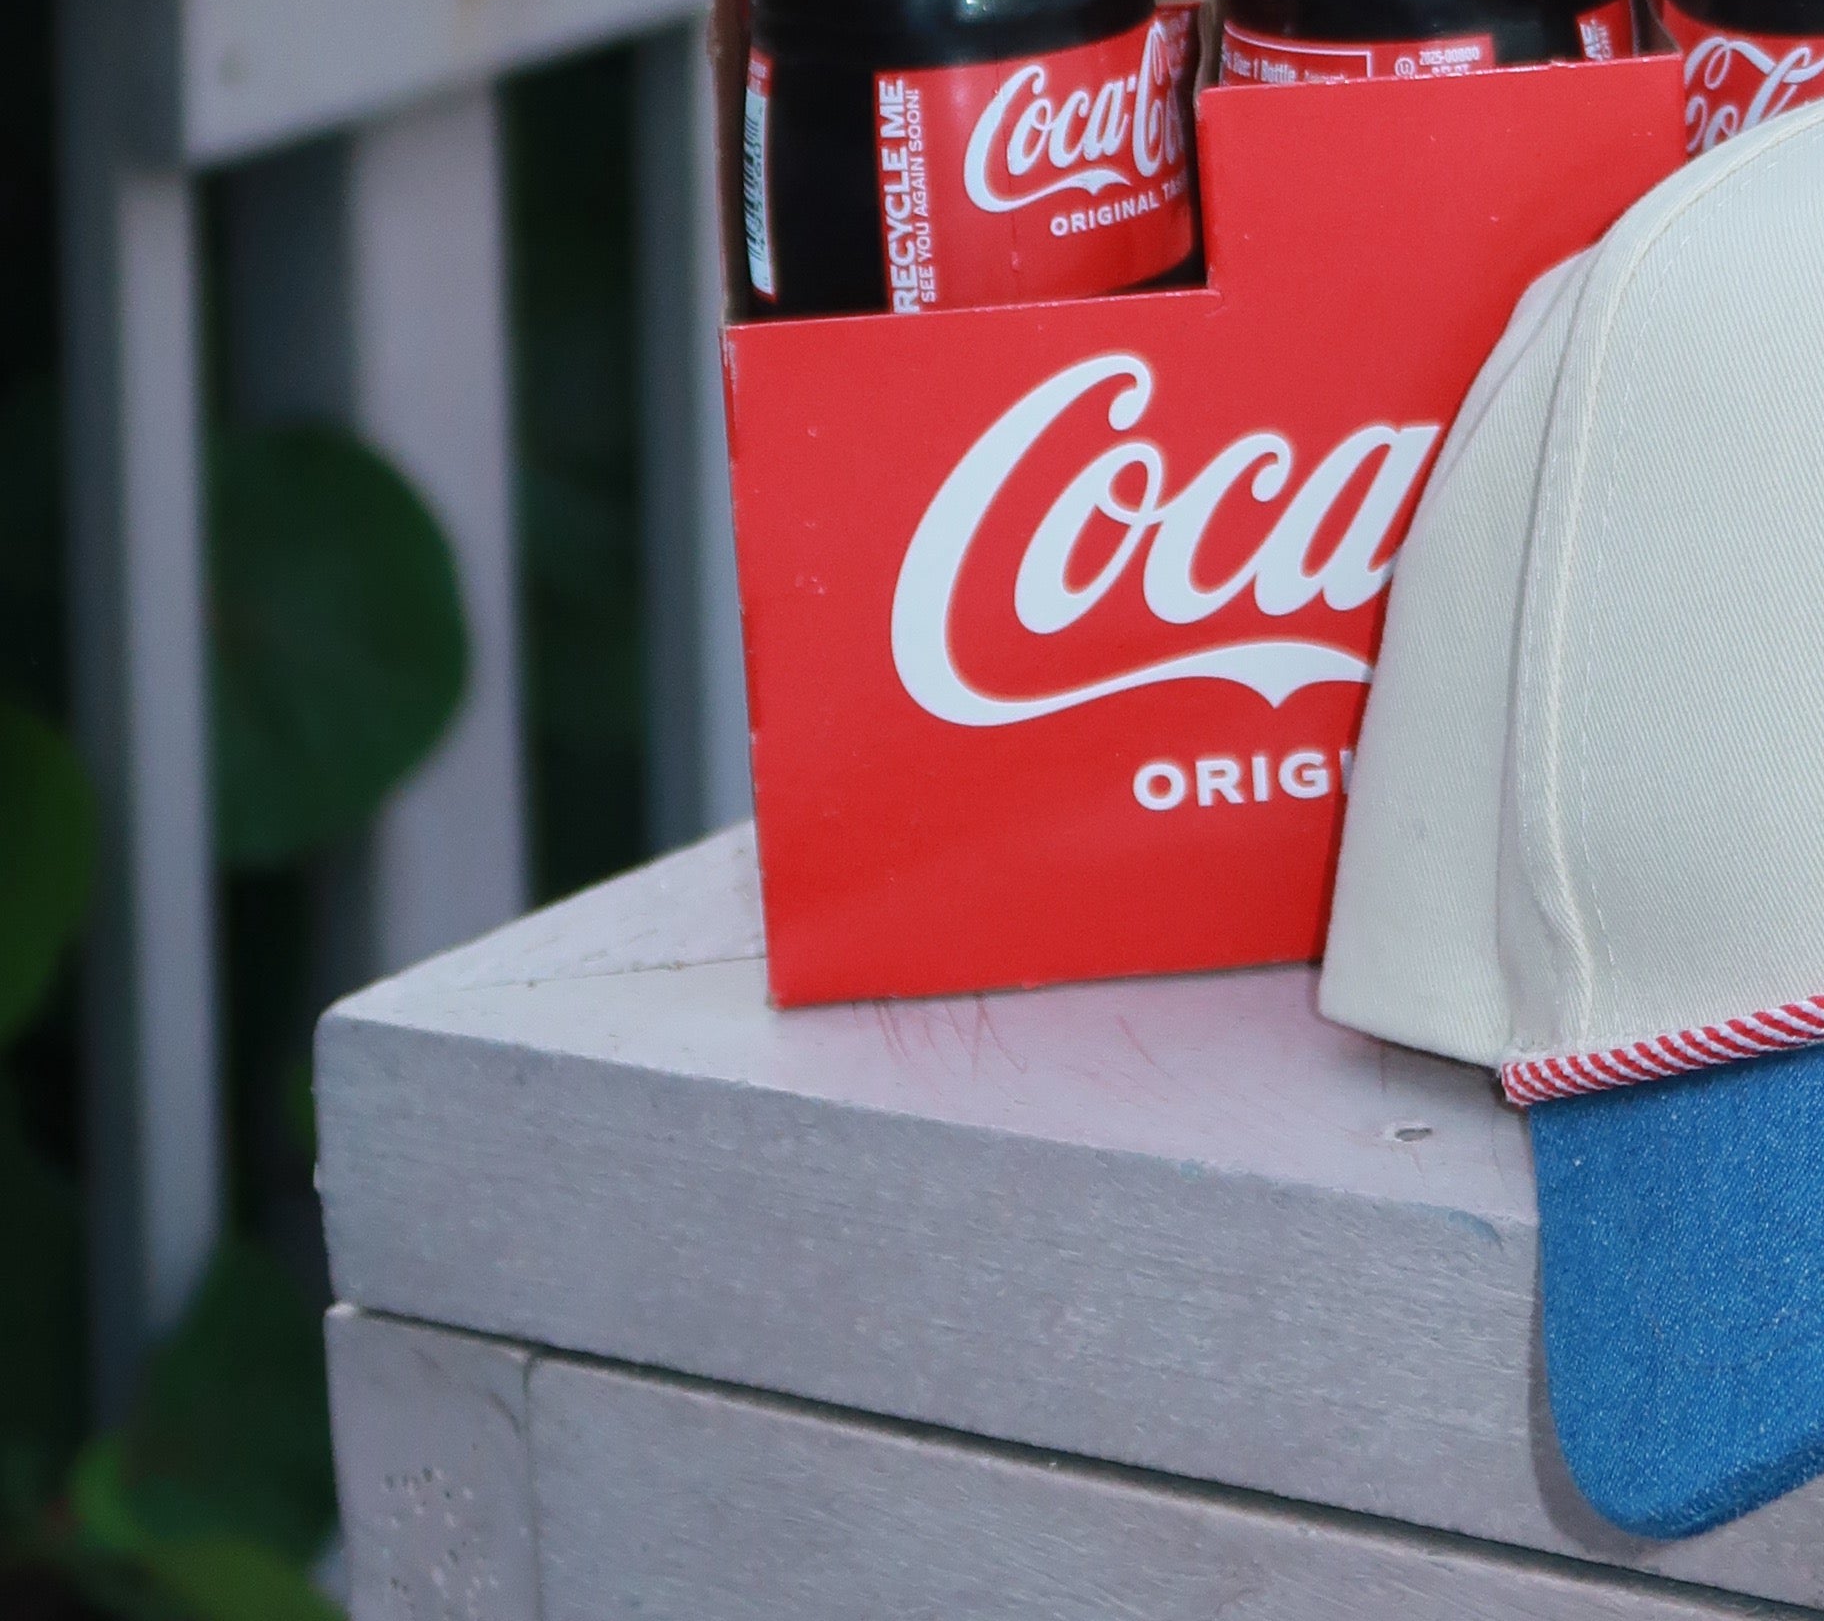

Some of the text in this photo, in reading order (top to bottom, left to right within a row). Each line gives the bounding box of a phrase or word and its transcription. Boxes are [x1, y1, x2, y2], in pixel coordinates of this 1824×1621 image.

[878, 79, 920, 314] RECYCLE ME
[905, 88, 937, 303] SEE YOU AGAIN SOON!
[1050, 191, 1160, 237] ORIGINAL
